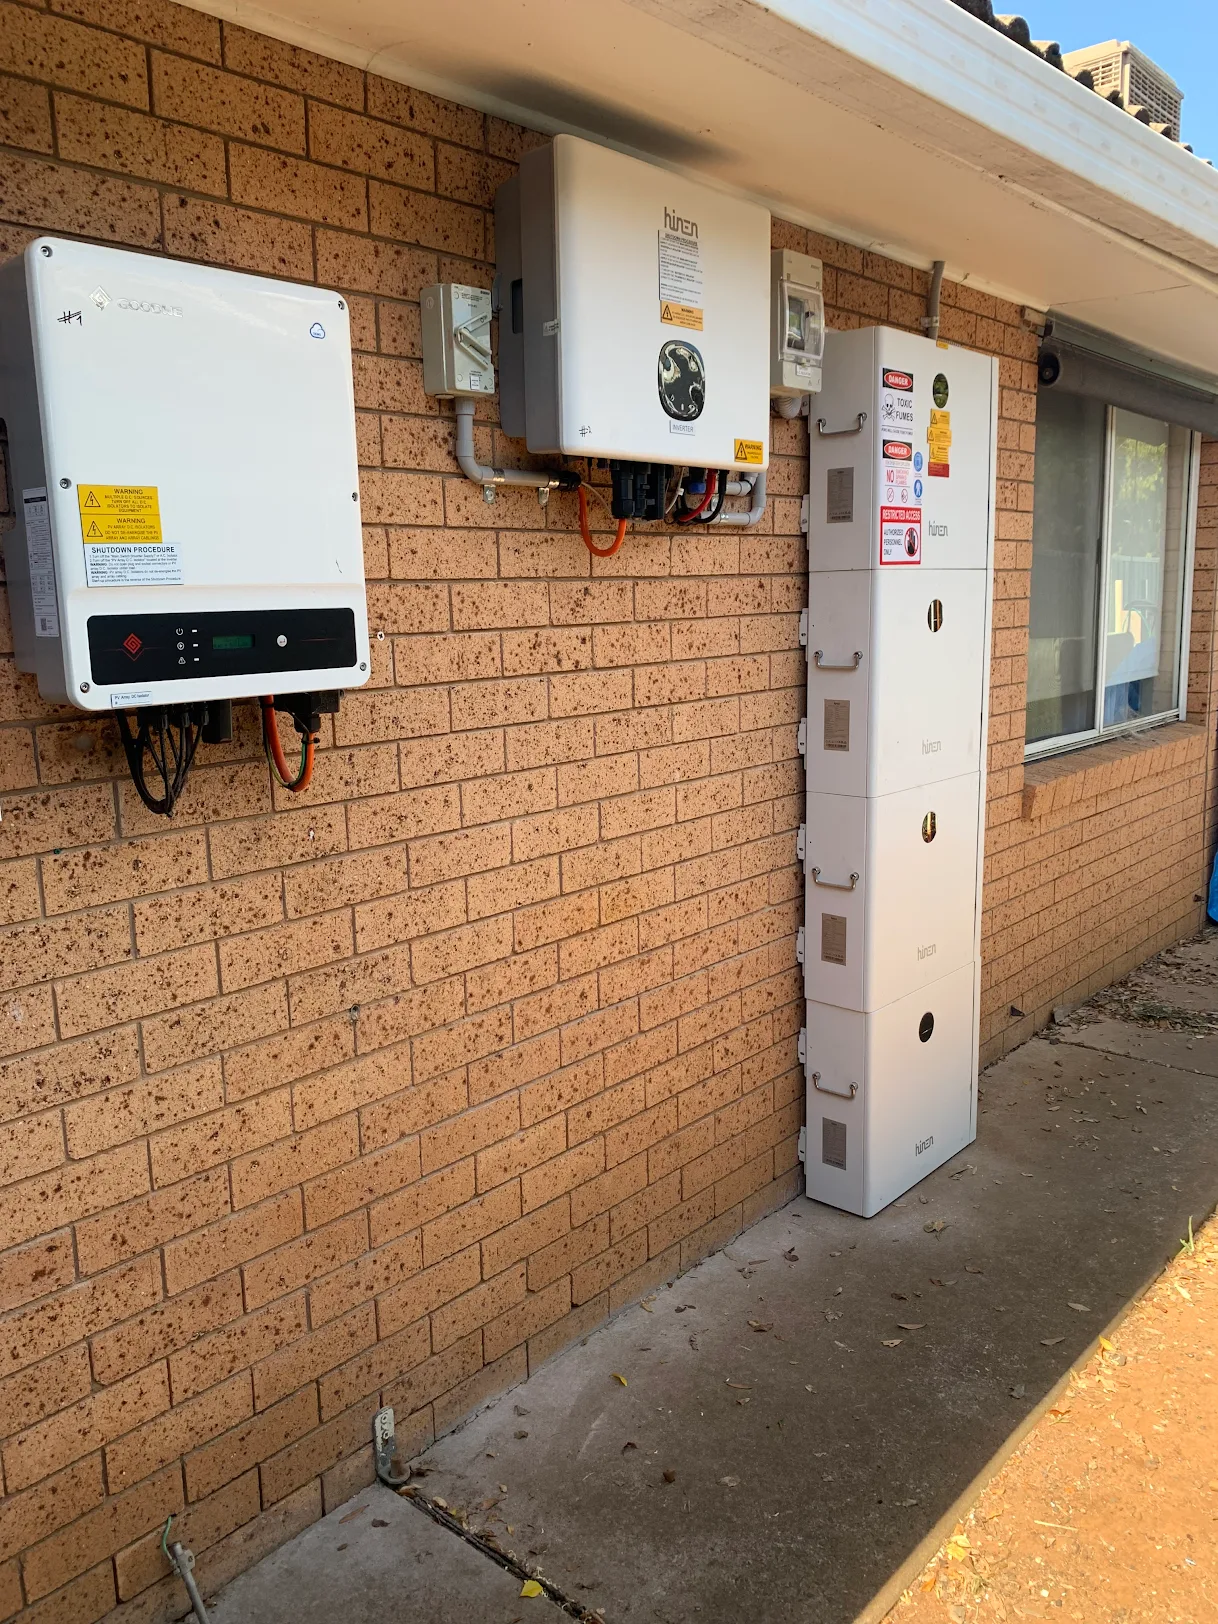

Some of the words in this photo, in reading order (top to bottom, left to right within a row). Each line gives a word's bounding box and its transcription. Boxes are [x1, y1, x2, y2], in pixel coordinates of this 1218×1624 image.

[57, 310, 82, 326] #1
[888, 374, 909, 386] DANGER
[897, 397, 912, 408] TOXIC
[896, 411, 913, 421] FUMES
[672, 423, 694, 433] INVERTER
[745, 443, 762, 451] WARNING
[888, 445, 907, 455] DANGER
[886, 469, 894, 483] NO
[882, 509, 906, 520] RESTRICTED
[906, 509, 920, 521] ACCESS
